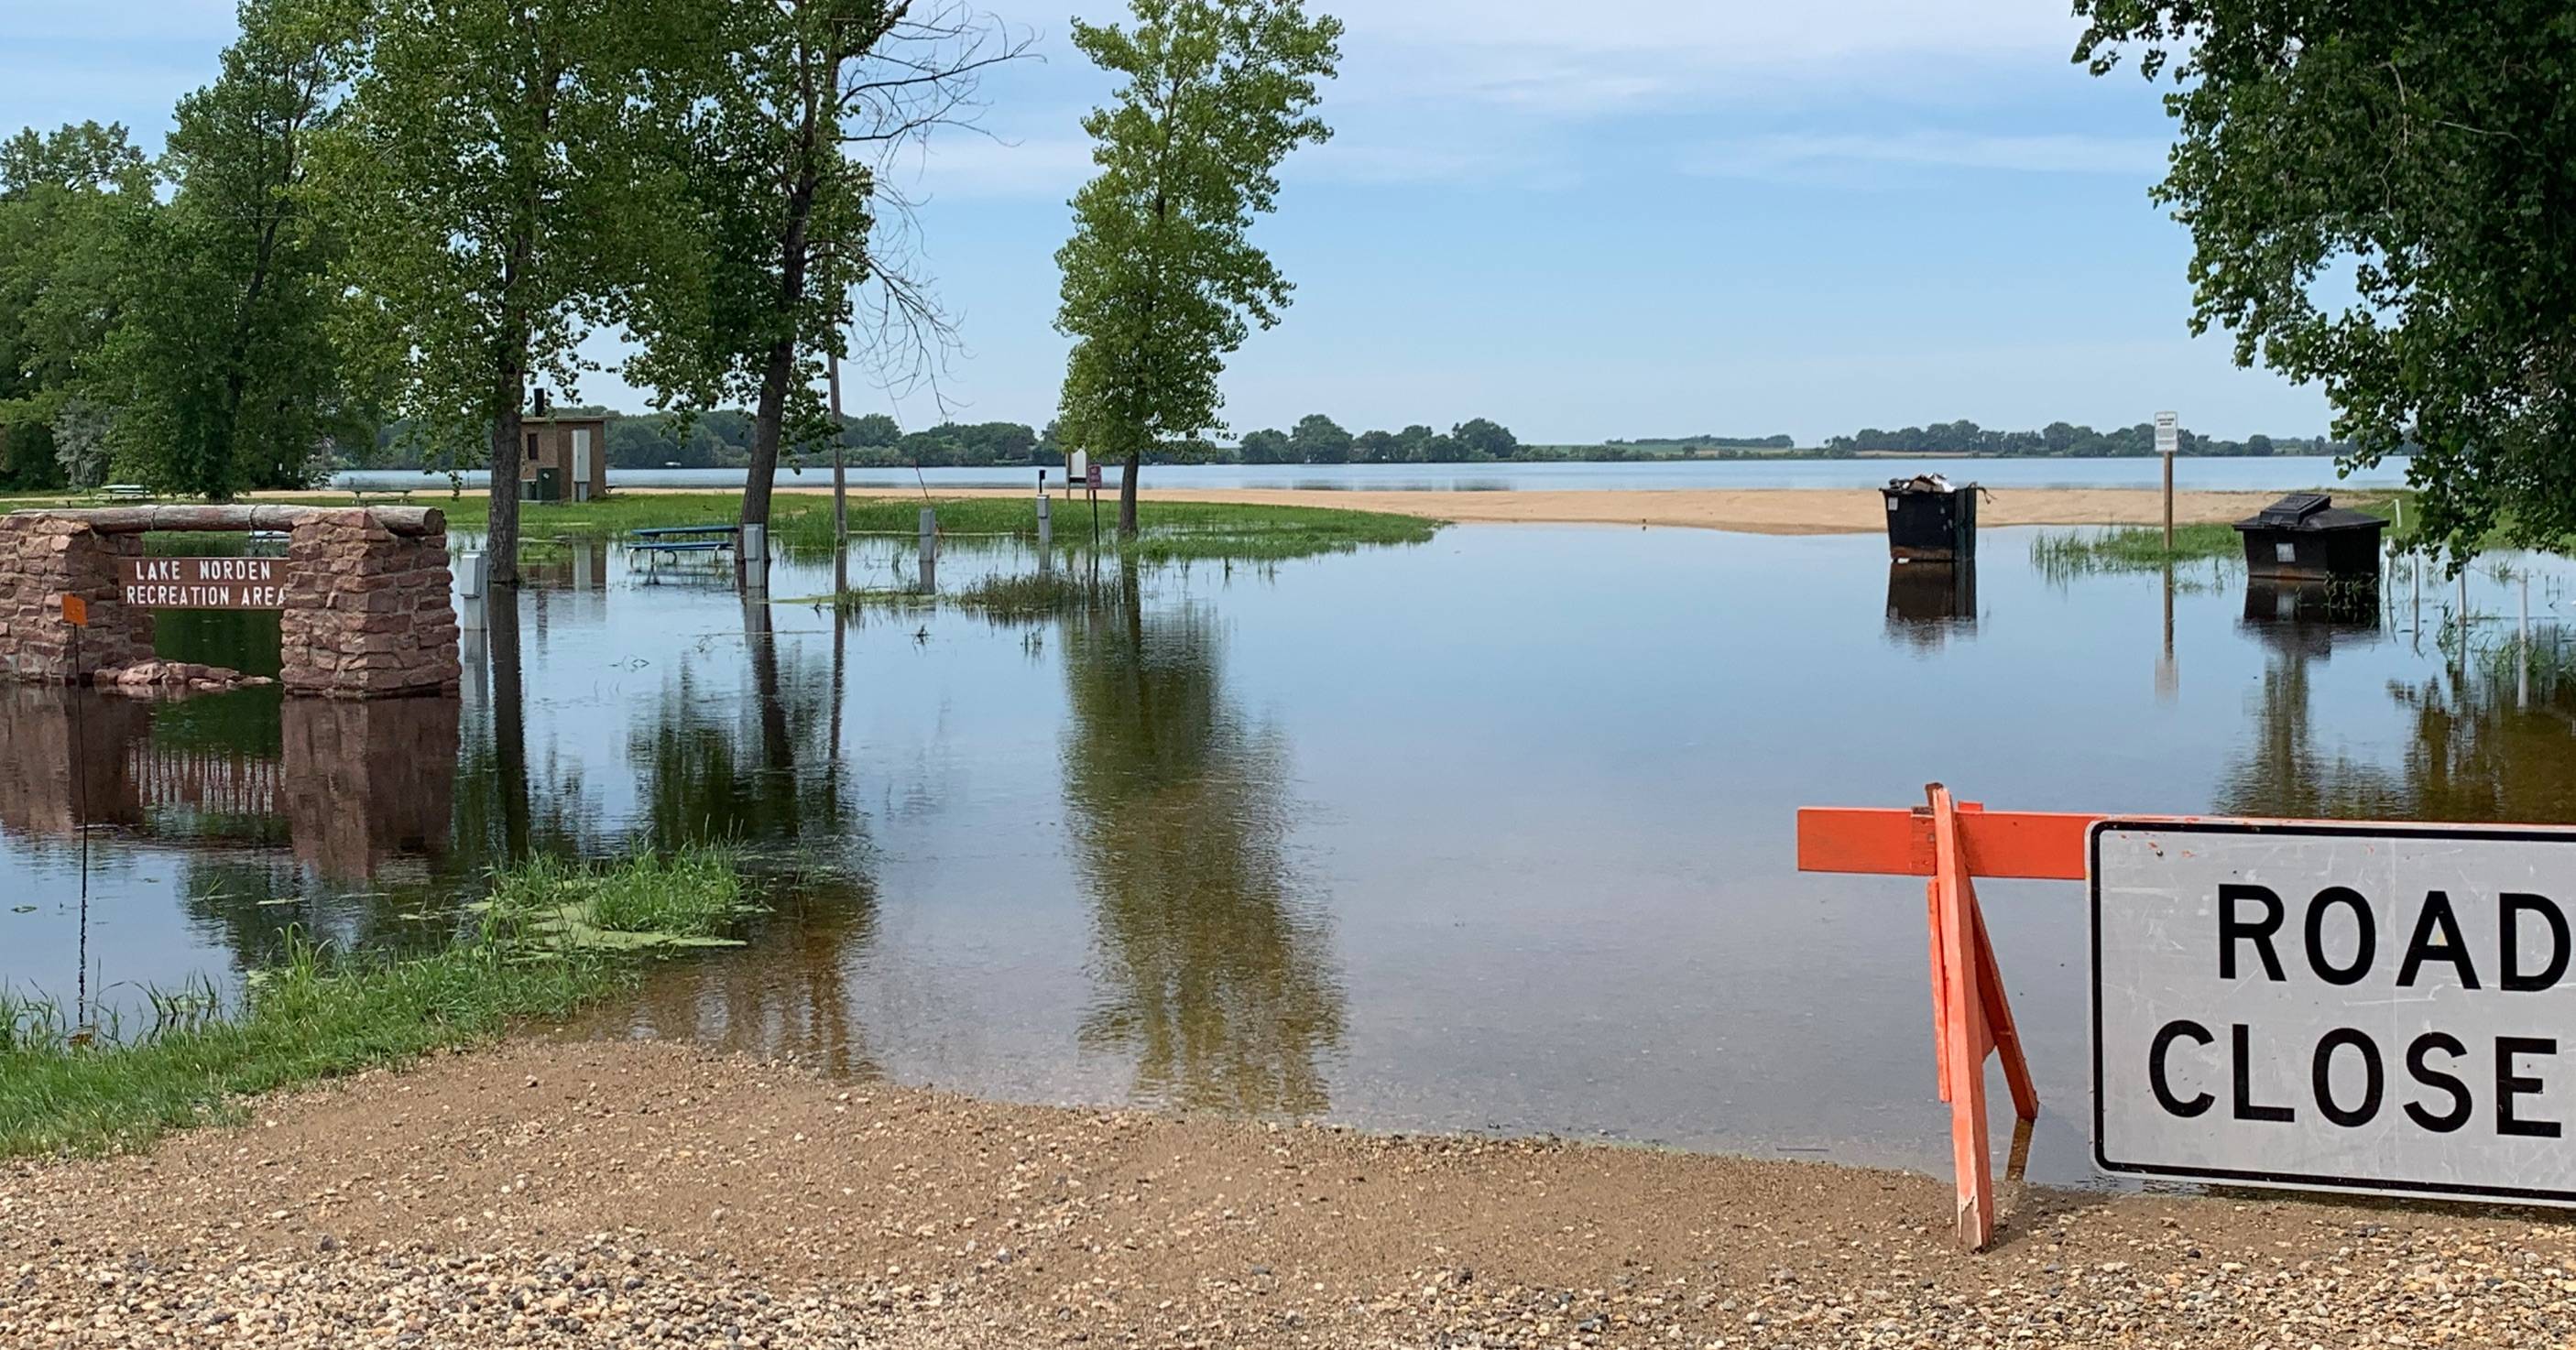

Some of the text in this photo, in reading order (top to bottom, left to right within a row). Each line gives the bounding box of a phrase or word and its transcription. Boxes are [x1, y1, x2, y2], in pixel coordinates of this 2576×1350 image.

[136, 561, 270, 580] LAKE NORDEN
[126, 585, 286, 606] RECREATION AREA
[2218, 883, 2571, 992] ROAD
